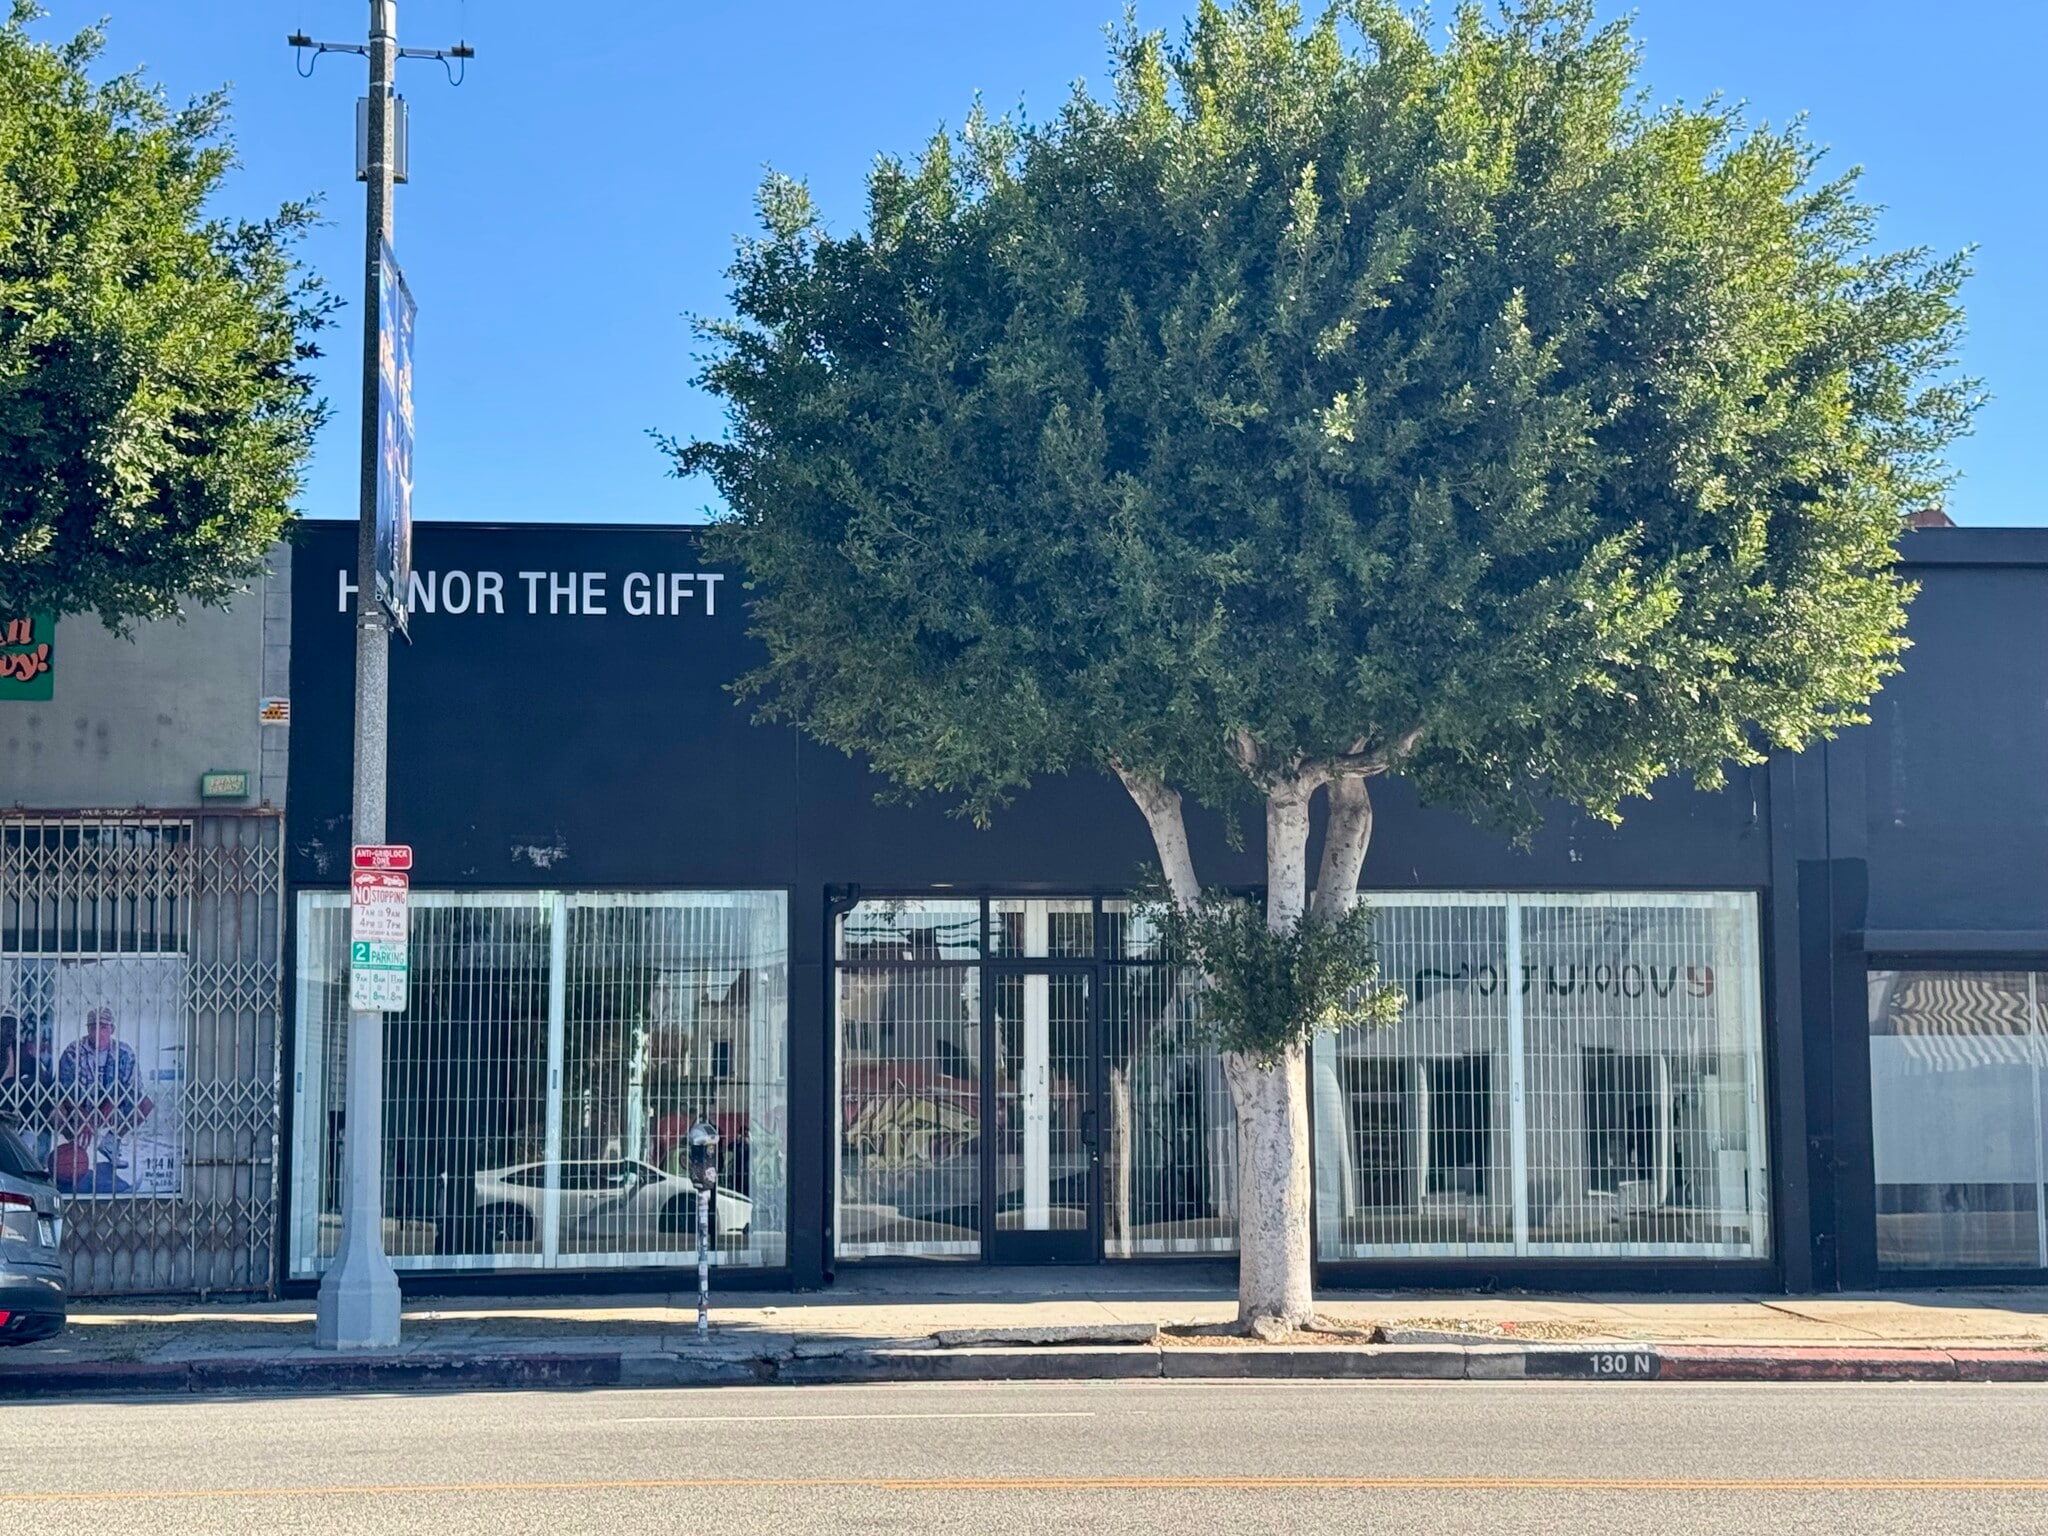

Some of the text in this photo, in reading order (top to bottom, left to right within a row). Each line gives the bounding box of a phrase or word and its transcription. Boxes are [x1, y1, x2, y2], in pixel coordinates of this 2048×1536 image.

[338, 569, 725, 616] HNOR THE GIFT
[372, 856, 391, 865] ZONE
[353, 886, 406, 904] NO STOPPING
[360, 906, 375, 916] 7AM
[385, 907, 400, 917] 9AM
[359, 918, 375, 928] 4PM
[386, 919, 401, 929] 7PM
[355, 943, 367, 961] 2
[371, 951, 405, 965] PARKING
[1590, 1355, 1650, 1373] 130 N
